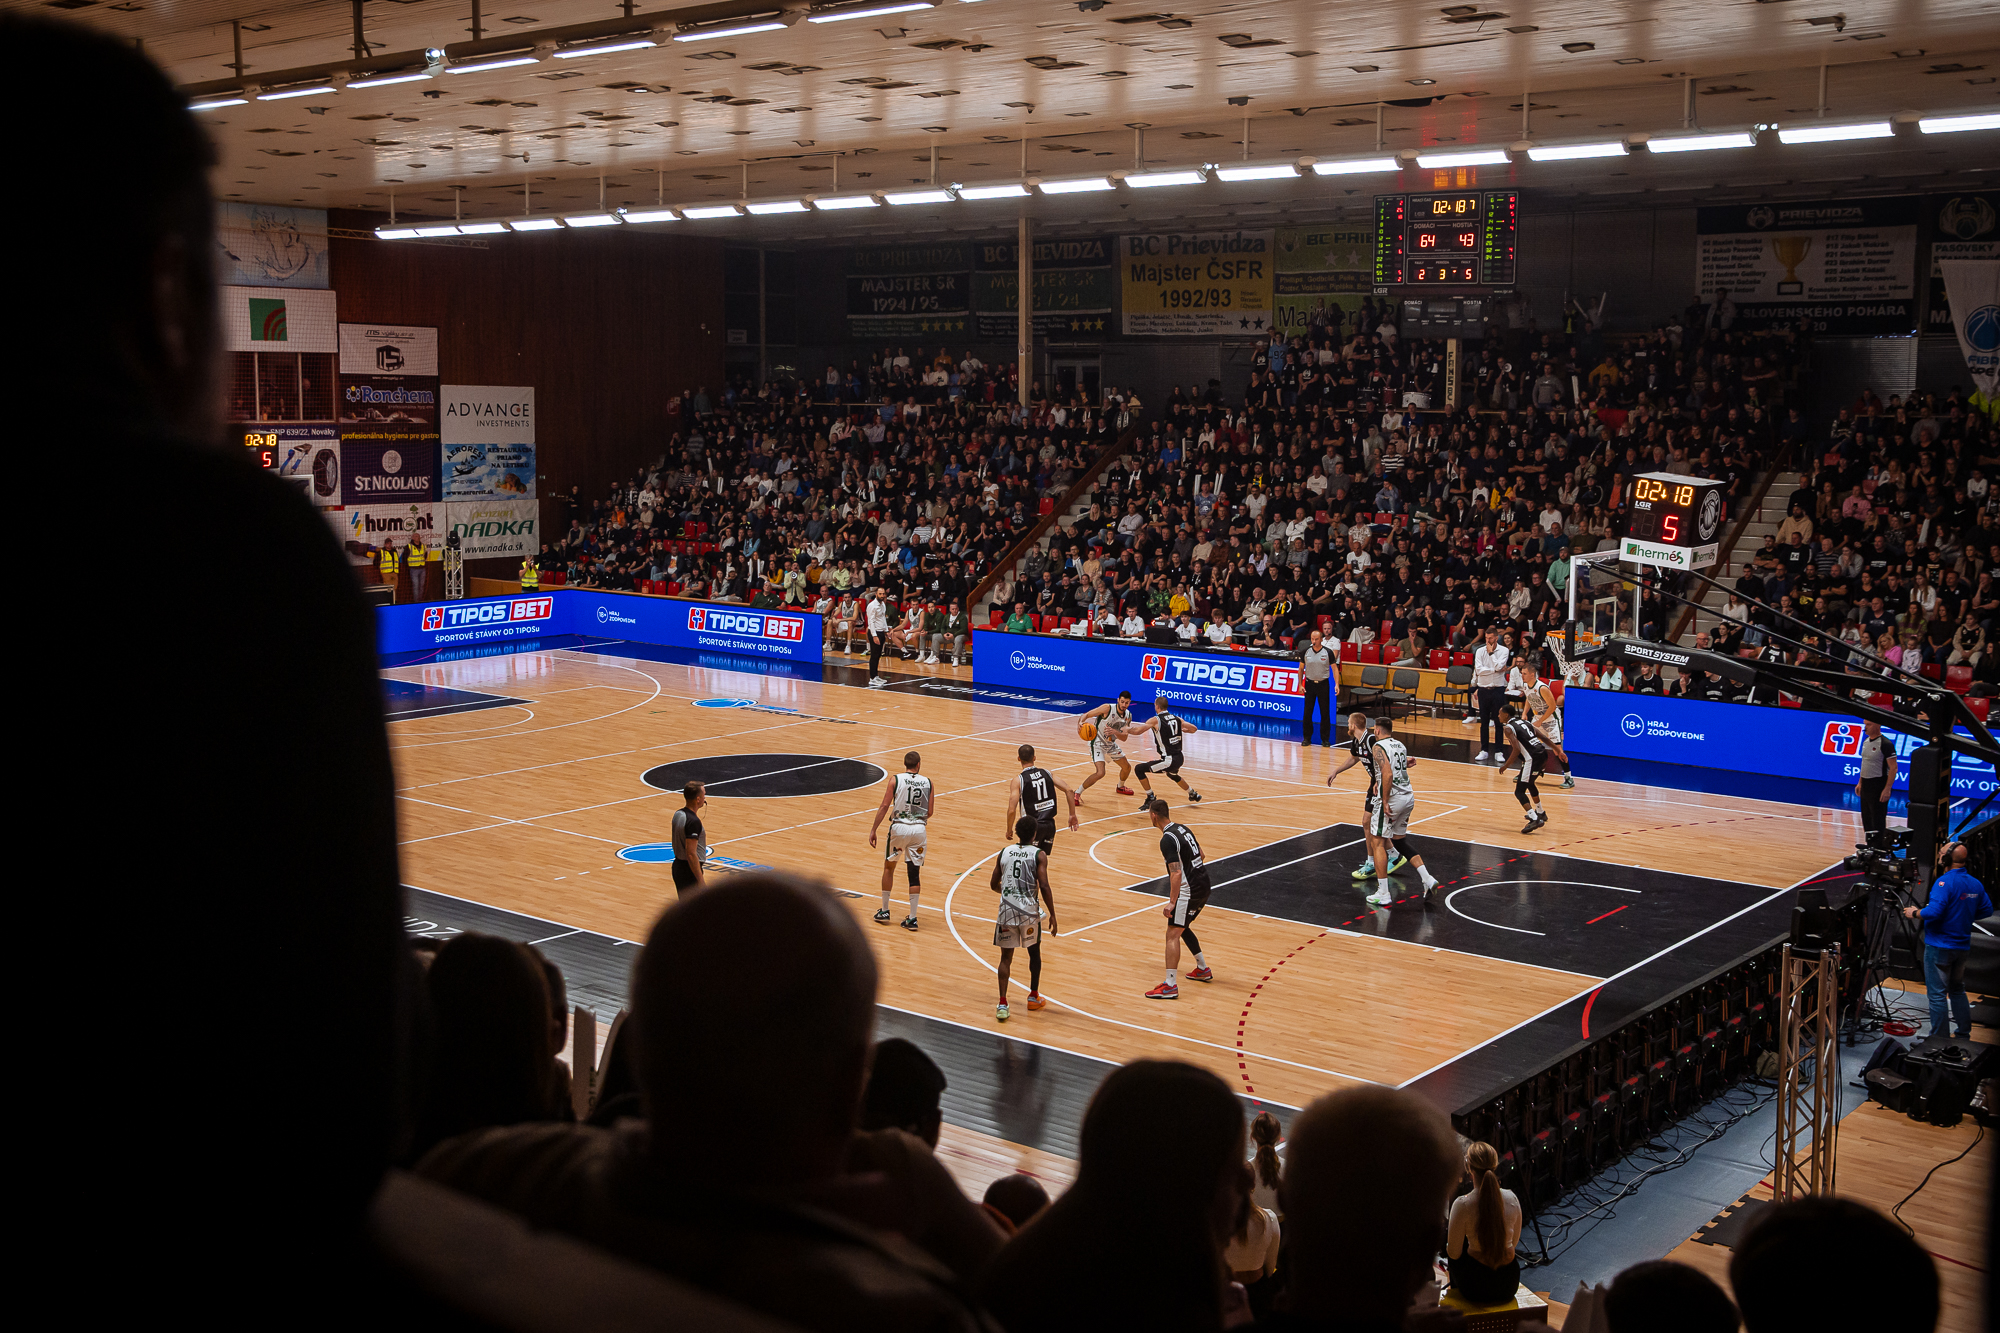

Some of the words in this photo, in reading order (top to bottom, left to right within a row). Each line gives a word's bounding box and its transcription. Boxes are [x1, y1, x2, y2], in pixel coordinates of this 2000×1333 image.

[1779, 207, 1863, 219] PRIEVIDZA
[1129, 236, 1161, 256] BC
[1167, 232, 1266, 255] Prievidza
[1306, 234, 1330, 246] BC
[1420, 234, 1436, 248] 64
[1459, 233, 1474, 247] 43
[984, 246, 1008, 263] BC
[1074, 272, 1095, 286] SR
[1131, 263, 1201, 286] Majster
[1207, 257, 1263, 280] ČSFR
[1418, 269, 1425, 280] 2
[1439, 269, 1446, 280] 3
[1465, 268, 1472, 280] 5
[861, 277, 932, 292] MAJSTER
[936, 276, 956, 290] SR
[1159, 289, 1231, 308] 1992/93
[1743, 306, 1842, 318] SLOVENSKÉHO
[1847, 304, 1906, 317] POHÁRA
[1968, 355, 2000, 365] FIBA
[361, 386, 434, 403] Ronchem
[446, 402, 530, 417] ADVANCE
[476, 420, 530, 428] INVESTMENTS
[311, 428, 336, 437] Nováky
[341, 432, 384, 441] profesionálna
[384, 432, 408, 441] hygiena
[409, 433, 420, 441] pre
[420, 433, 440, 441] gastro
[262, 452, 272, 468] 5
[446, 445, 487, 462] AEROREST
[1635, 500, 1653, 510] LGR
[1662, 514, 1680, 542] 5
[465, 542, 523, 554] www.nadka.sk
[1637, 544, 1685, 565] hermés
[448, 604, 507, 625] TIPOS
[514, 600, 550, 623] BET
[709, 613, 762, 634] TIPOS
[766, 619, 801, 638] BET
[435, 632, 475, 643] ŠPORTOVÉ
[475, 629, 502, 640] STÁVKY
[503, 627, 514, 636] OD
[698, 636, 732, 649] ŠPORTOVÉ
[732, 639, 757, 651] STÁVKY
[757, 643, 768, 652] OD
[1012, 656, 1024, 664] 18+
[1027, 655, 1043, 663] HRAJ
[1027, 662, 1066, 672] ZODPOVEDNE
[1171, 660, 1247, 687] TIPOS
[1256, 669, 1301, 693] BET
[1155, 687, 1203, 703] ŠPORTOVÉ
[1205, 693, 1239, 707] STÁVKY
[1241, 699, 1256, 709] OD
[1258, 701, 1291, 713] TIPOSu
[1167, 719, 1178, 736] 17
[1625, 720, 1642, 730] 18+
[1647, 719, 1670, 729] HRAJ
[1647, 727, 1706, 741] ZODPOVEDNE
[1393, 751, 1407, 771] 32
[906, 786, 922, 806] 12
[1031, 778, 1048, 801] 77
[1009, 850, 1028, 858] Smith
[1013, 860, 1021, 879] 6
